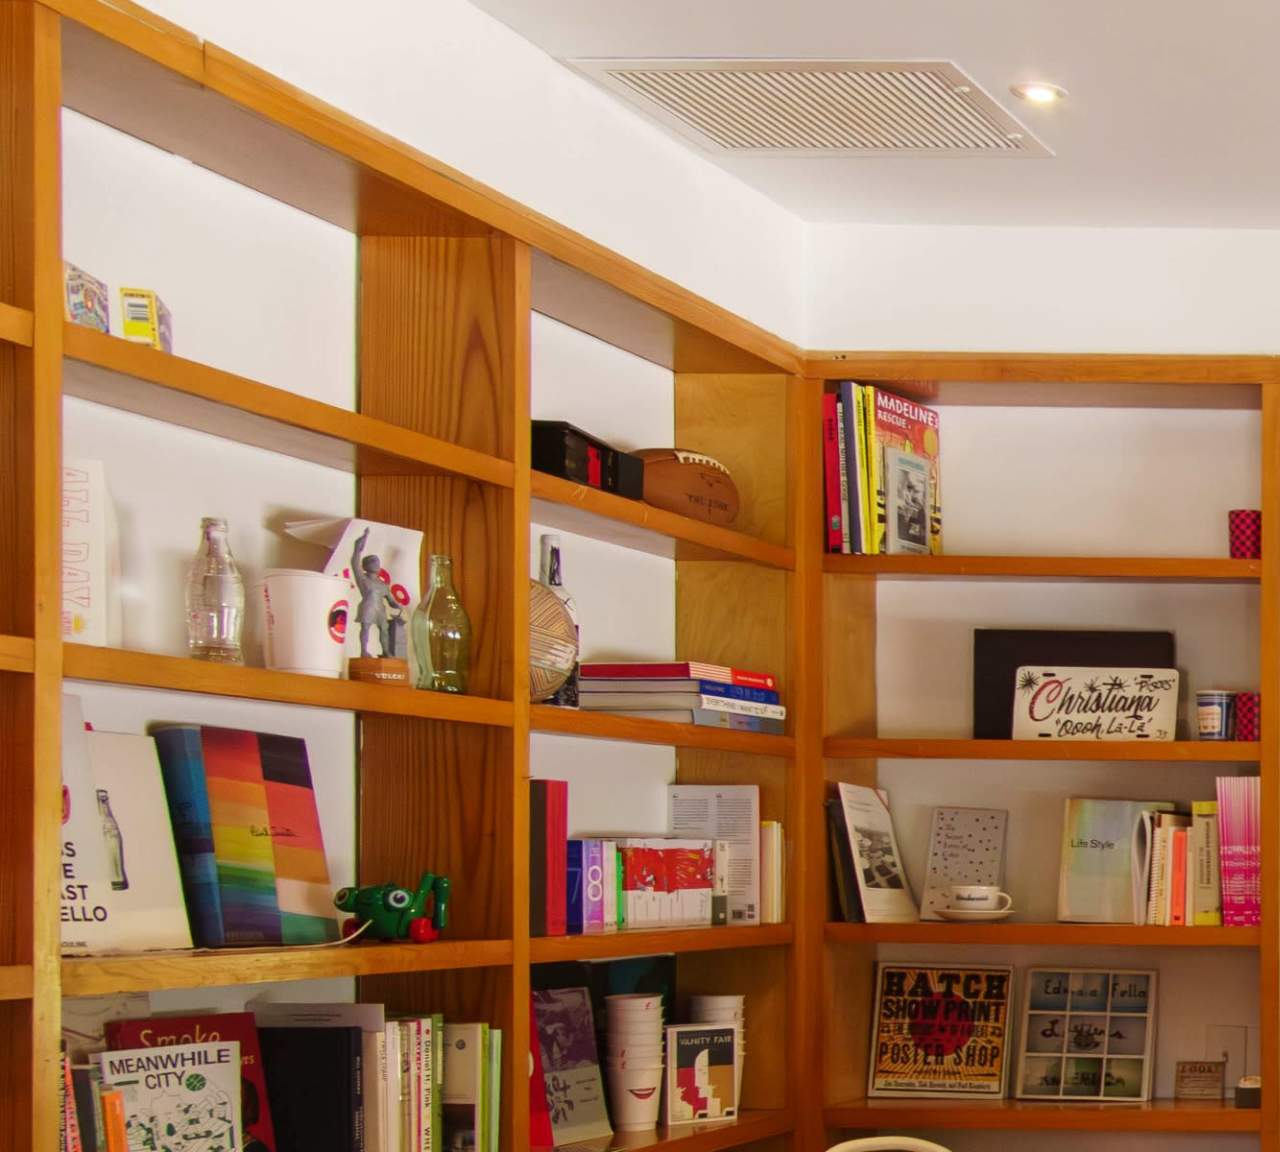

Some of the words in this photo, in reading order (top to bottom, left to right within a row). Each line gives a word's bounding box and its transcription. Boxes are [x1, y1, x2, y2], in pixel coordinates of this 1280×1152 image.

[877, 410, 908, 429] RESCUE
[1029, 676, 1160, 722] Christiana
[1071, 839, 1088, 848] Life
[1089, 839, 1115, 851] Style
[60, 905, 108, 922] ELLO
[885, 971, 1008, 1000] HATCH
[881, 999, 939, 1021] SHOW
[943, 1000, 1008, 1023] PRINT
[139, 1024, 221, 1047] Smoke
[680, 1037, 711, 1046] VANITY
[713, 1035, 732, 1043] FAIR
[109, 1048, 231, 1075] MEANWHILE
[878, 1042, 945, 1066] POSTER
[953, 1045, 1001, 1067] SHOP
[145, 1070, 187, 1090] CITY
